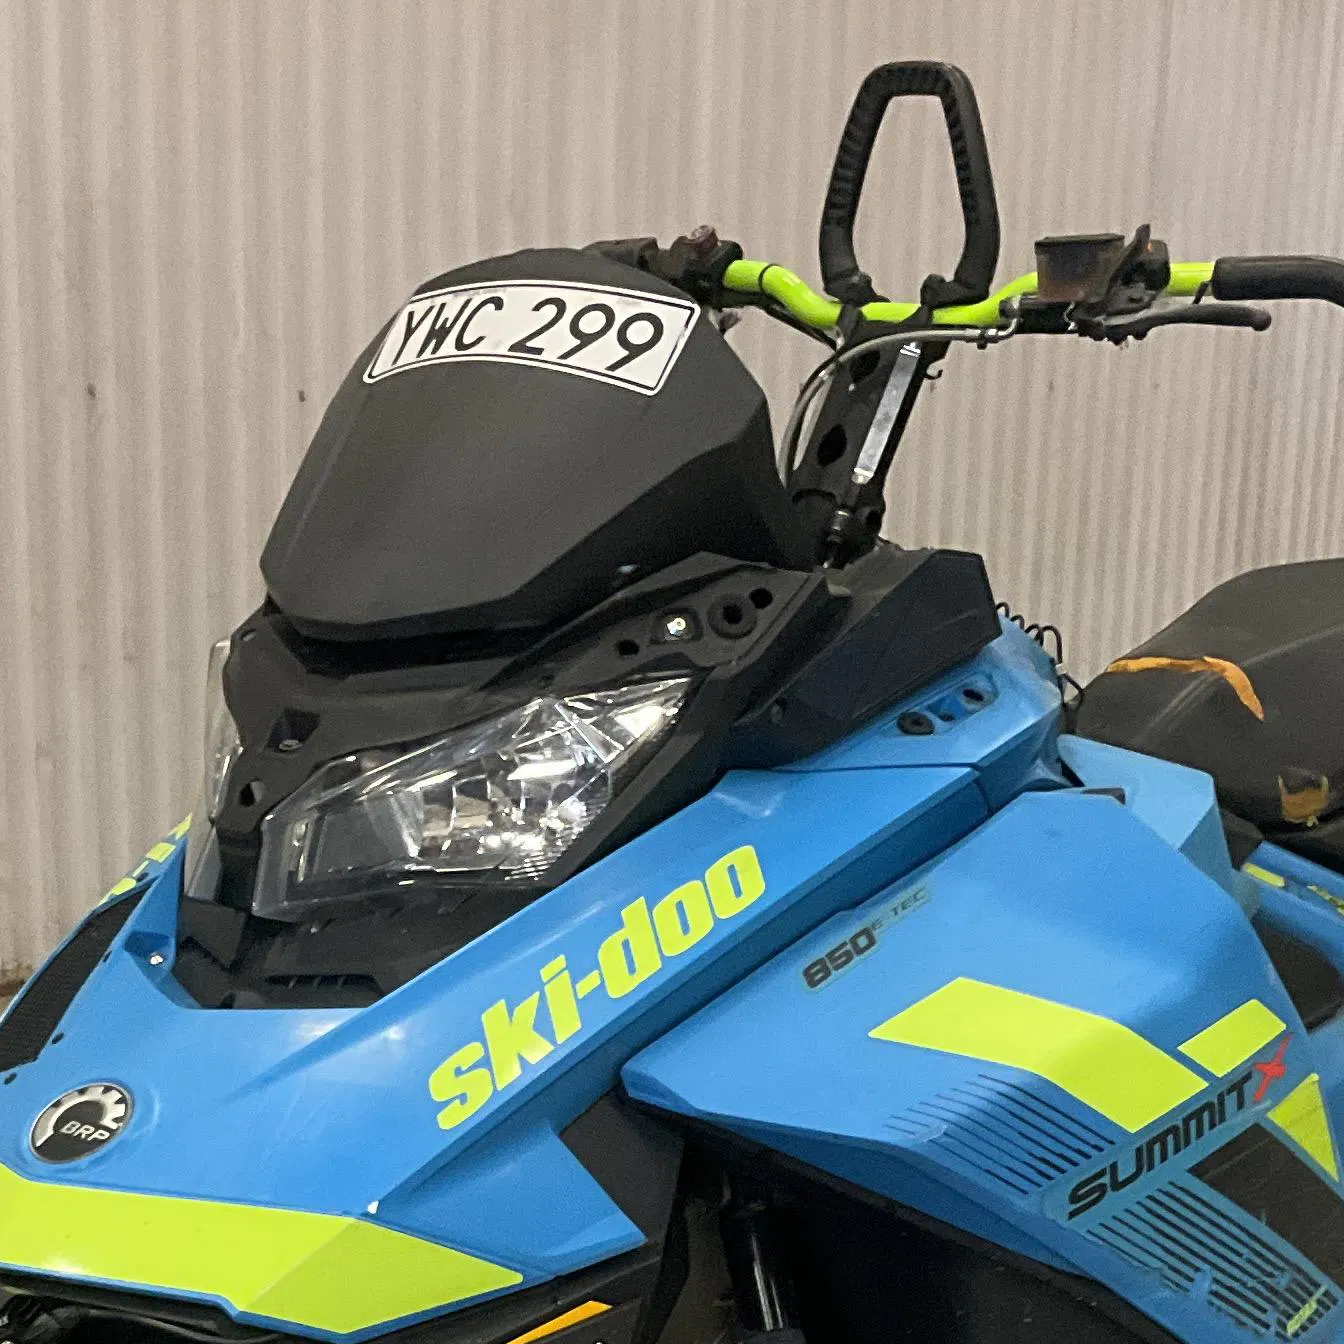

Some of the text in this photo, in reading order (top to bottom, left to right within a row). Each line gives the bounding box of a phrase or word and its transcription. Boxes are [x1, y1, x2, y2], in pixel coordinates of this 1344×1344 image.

[392, 296, 665, 372] YWC 299
[428, 844, 766, 1131] ski-doo
[802, 926, 877, 989] 850
[60, 1120, 110, 1141] BRP
[1068, 1070, 1253, 1221] SUMMIT
